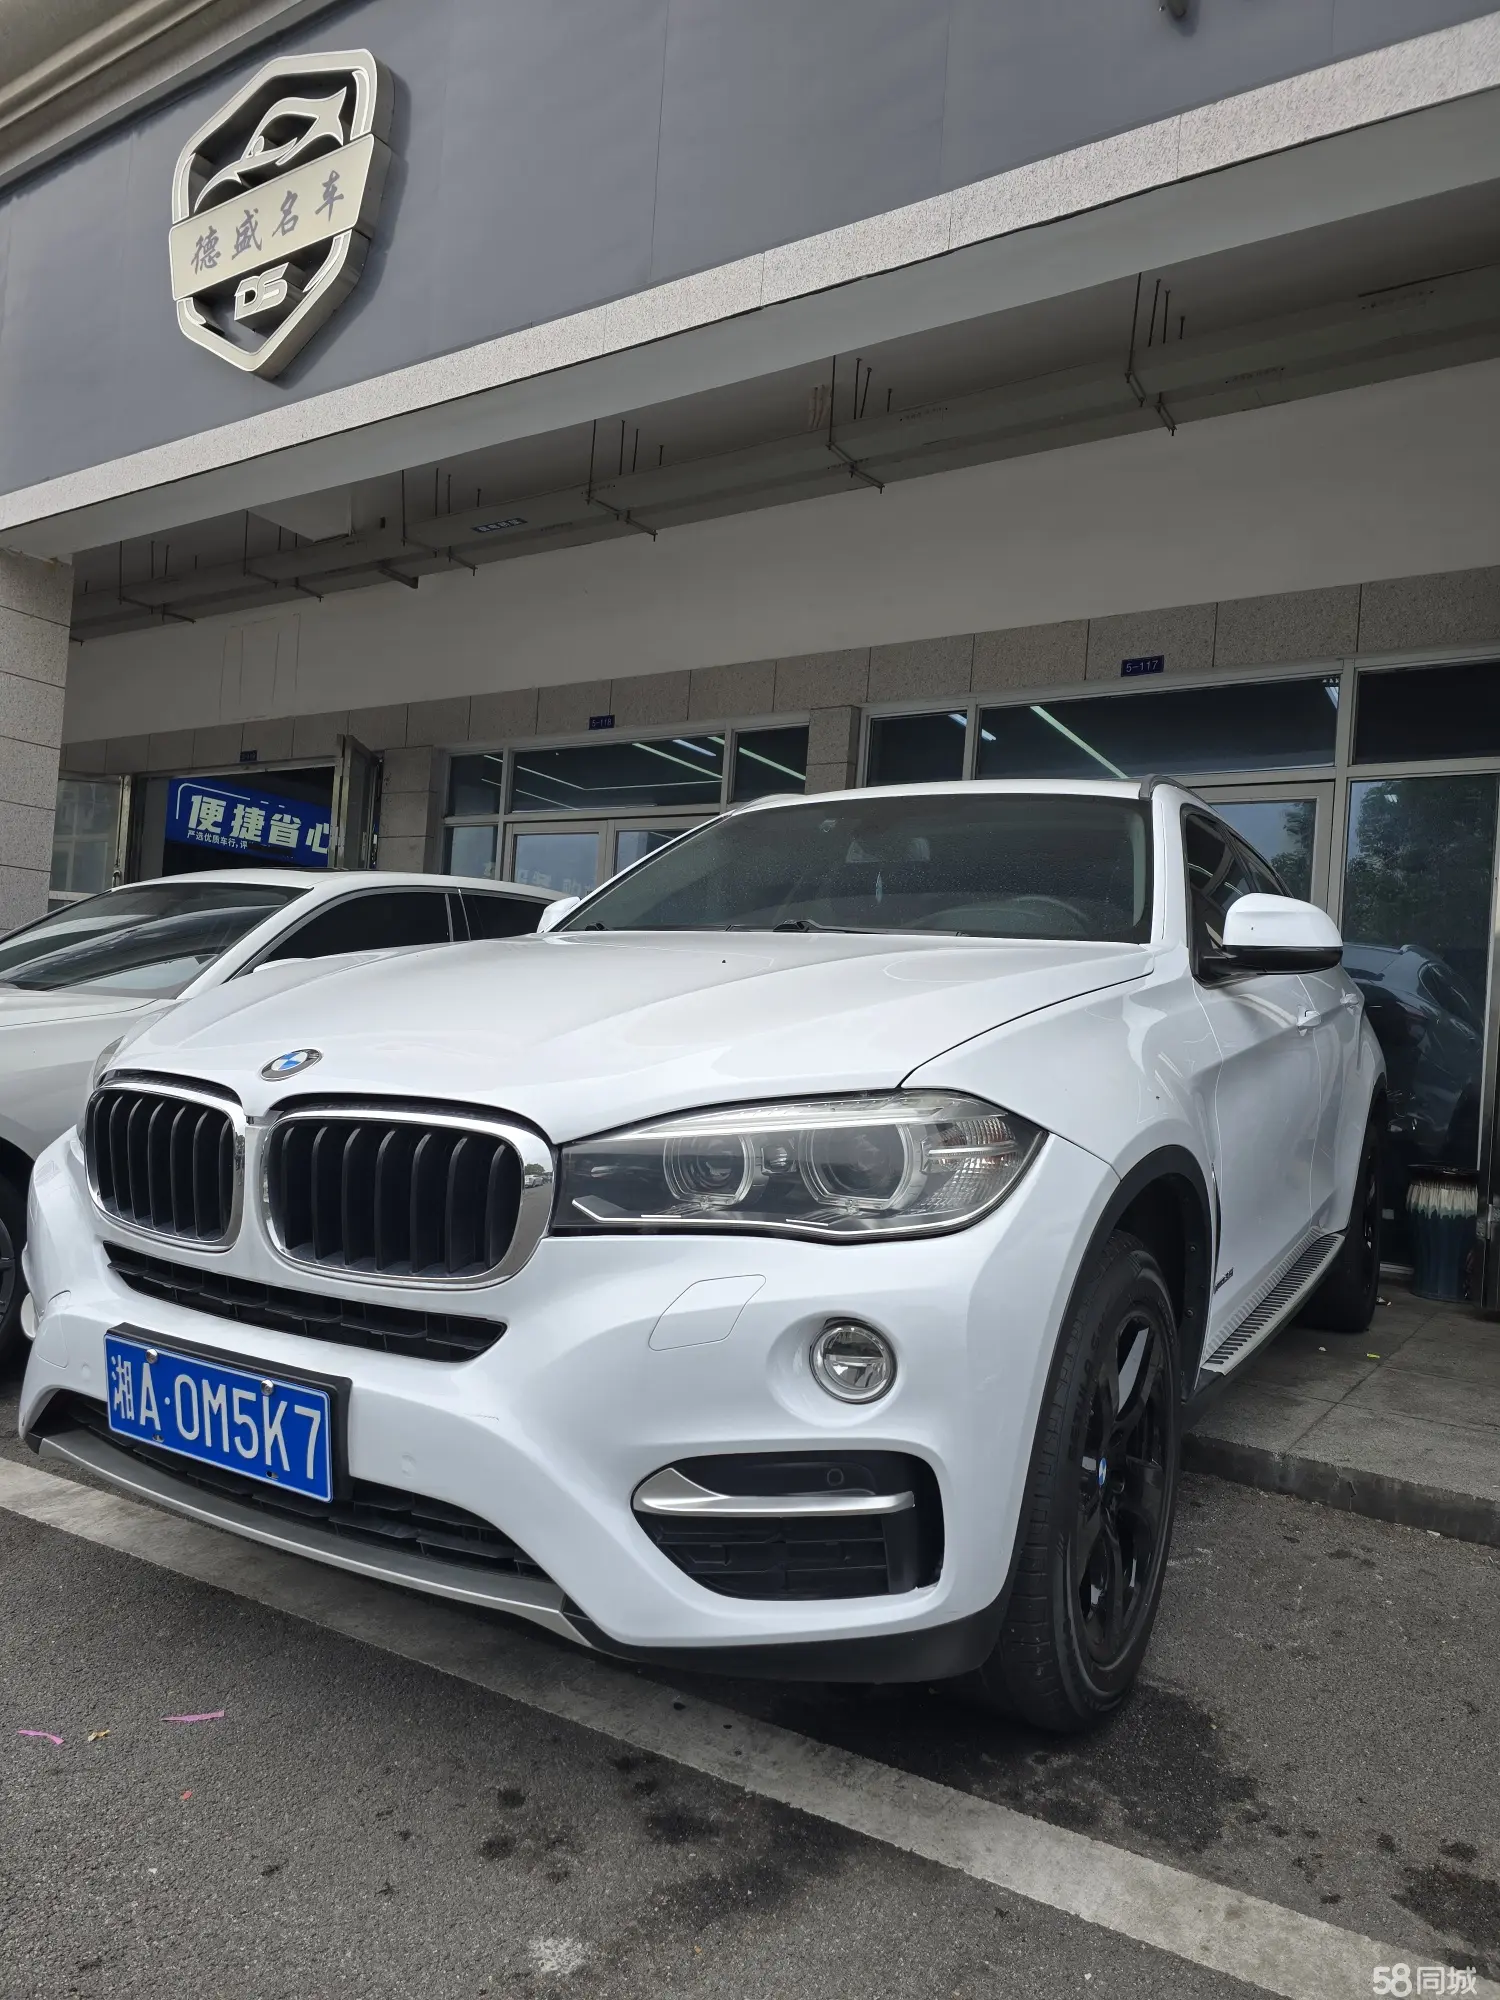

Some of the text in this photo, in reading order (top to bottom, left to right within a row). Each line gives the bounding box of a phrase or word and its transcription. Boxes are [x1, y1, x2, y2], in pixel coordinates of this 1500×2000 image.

[190, 169, 345, 275] 德盛名车
[233, 261, 290, 321] DS
[1126, 660, 1159, 673] 5-117
[187, 794, 330, 855] 便捷省心
